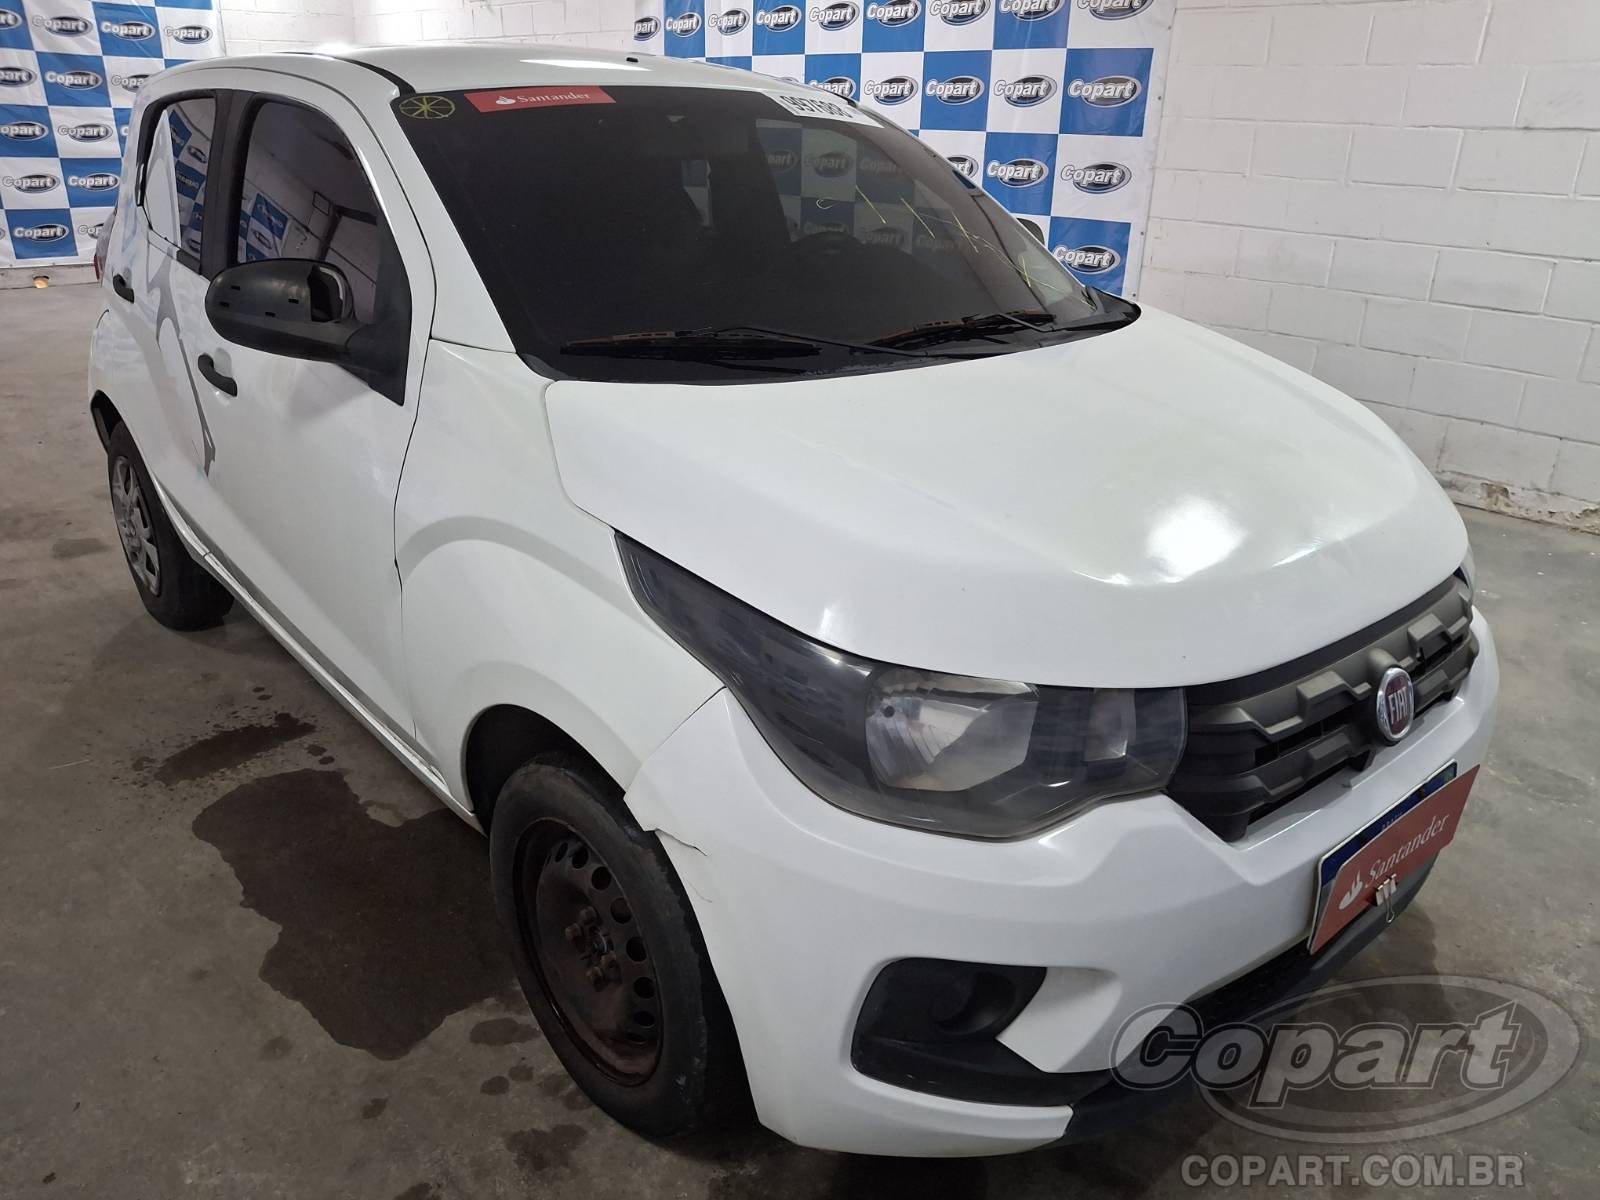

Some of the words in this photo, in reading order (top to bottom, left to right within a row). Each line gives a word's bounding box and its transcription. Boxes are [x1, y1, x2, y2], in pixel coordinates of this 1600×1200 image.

[756, 9, 797, 27] Copart
[809, 5, 853, 25] Copart
[866, 2, 915, 22] Copart
[930, 0, 983, 19] Copart
[33, 16, 85, 31] Copart
[101, 21, 150, 37] Copart
[634, 20, 657, 34] part
[665, 17, 697, 34] Copart
[708, 13, 743, 31] Copart
[164, 26, 207, 41] Copart
[45, 71, 97, 87] Copart
[111, 75, 145, 88] Copa
[518, 91, 591, 103] Santander
[864, 80, 912, 99] Copart
[926, 79, 977, 100] Copart
[993, 79, 1048, 98] Copart
[1069, 79, 1134, 99] Copart
[0, 125, 42, 138] opart
[58, 125, 107, 138] Copart
[987, 160, 1041, 183] Copart
[1061, 165, 1124, 187] Copart
[3, 175, 54, 190] Copart
[68, 175, 116, 189] Copart
[14, 226, 63, 240] Copart
[1053, 246, 1111, 267] Copart
[1387, 687, 1408, 724] FIAT
[1364, 812, 1450, 888] Santander
